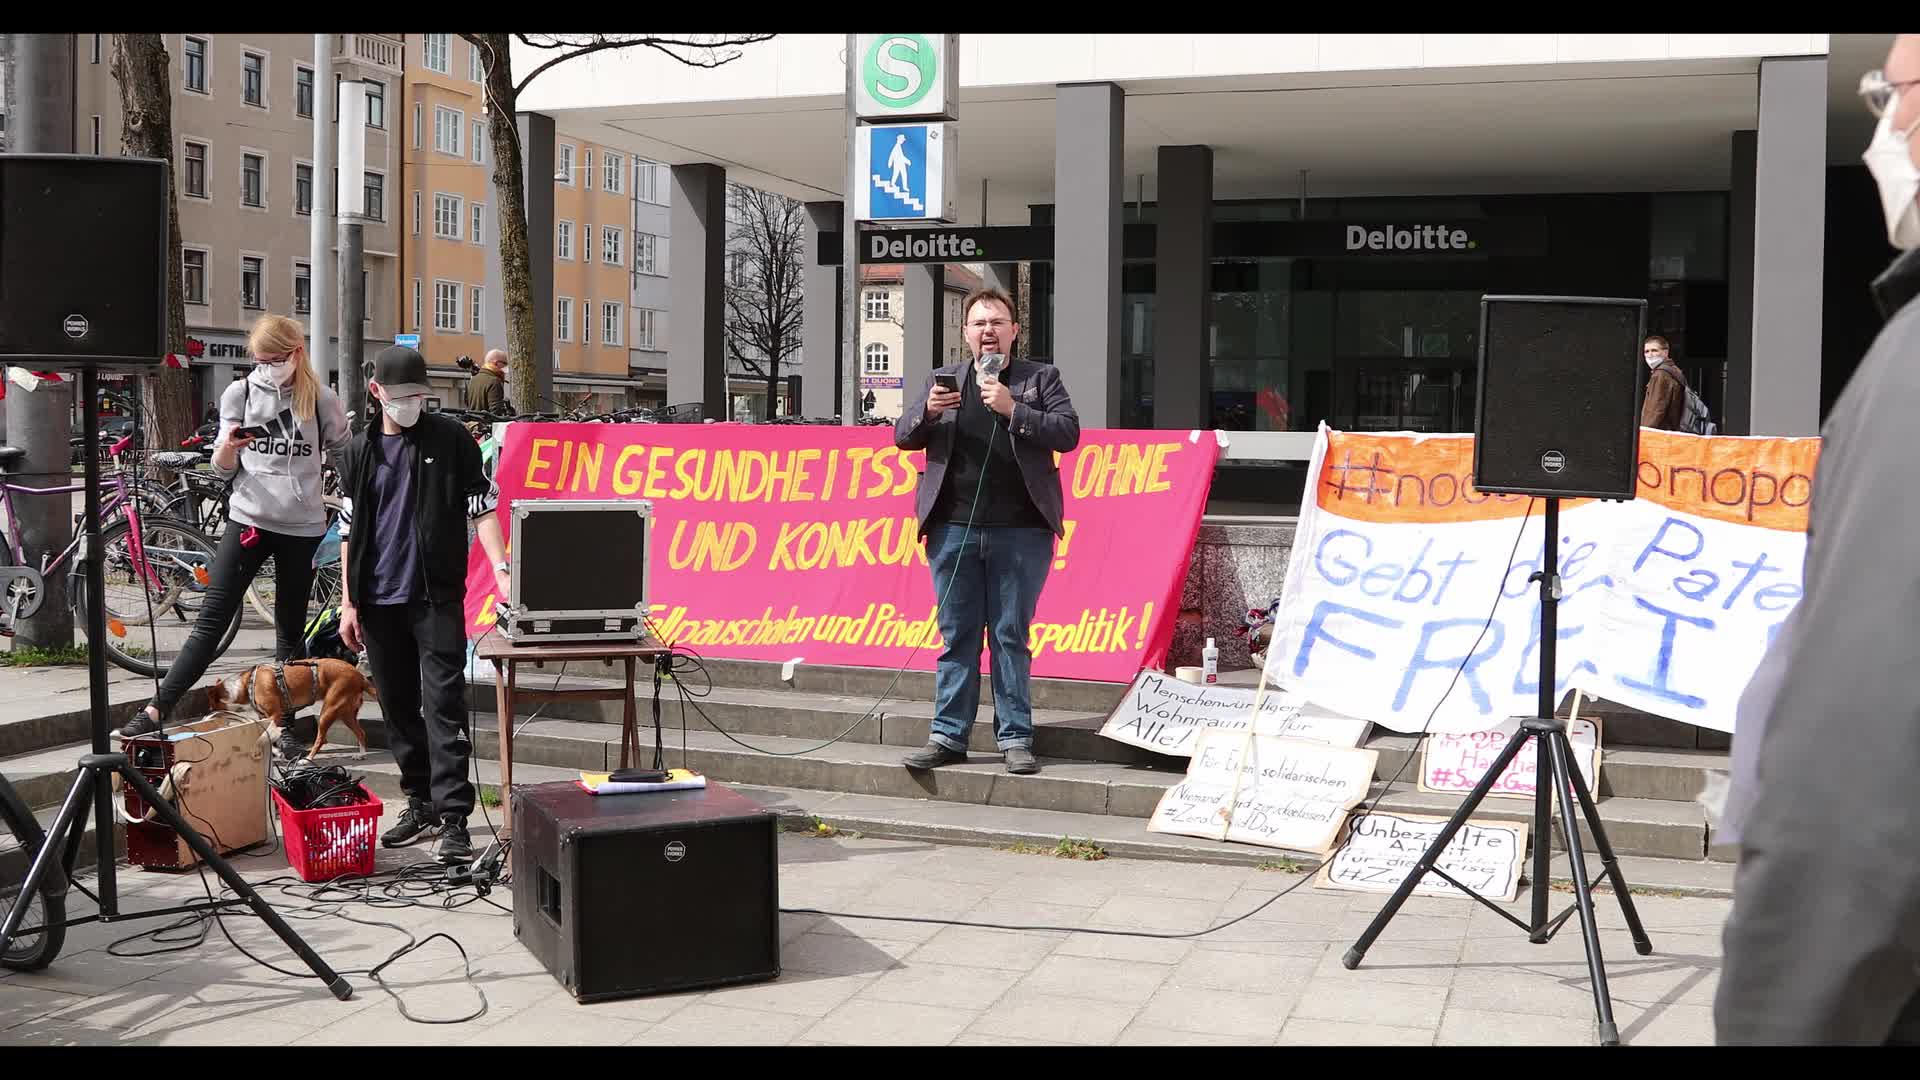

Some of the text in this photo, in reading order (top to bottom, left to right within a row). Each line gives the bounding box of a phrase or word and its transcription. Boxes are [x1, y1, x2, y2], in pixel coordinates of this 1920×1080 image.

[876, 37, 922, 99] S
[871, 233, 983, 258] Deloitte.
[1346, 224, 1477, 250] Deloitte.
[209, 343, 249, 358] GIFTH
[247, 435, 313, 457] adidas
[524, 438, 1183, 503] EIN GESUNDHEITSS OHNE
[668, 518, 758, 572] UND
[767, 516, 930, 572] KONKUR
[1314, 528, 1478, 607] Gebt
[1633, 516, 1803, 611] Pate
[812, 602, 876, 645] und
[1027, 600, 1154, 658] spolitik!
[1293, 576, 1720, 713] FREI
[1116, 716, 1193, 750] Alle!
[1357, 819, 1502, 848] Unbezalte
[1436, 861, 1497, 875] rise
